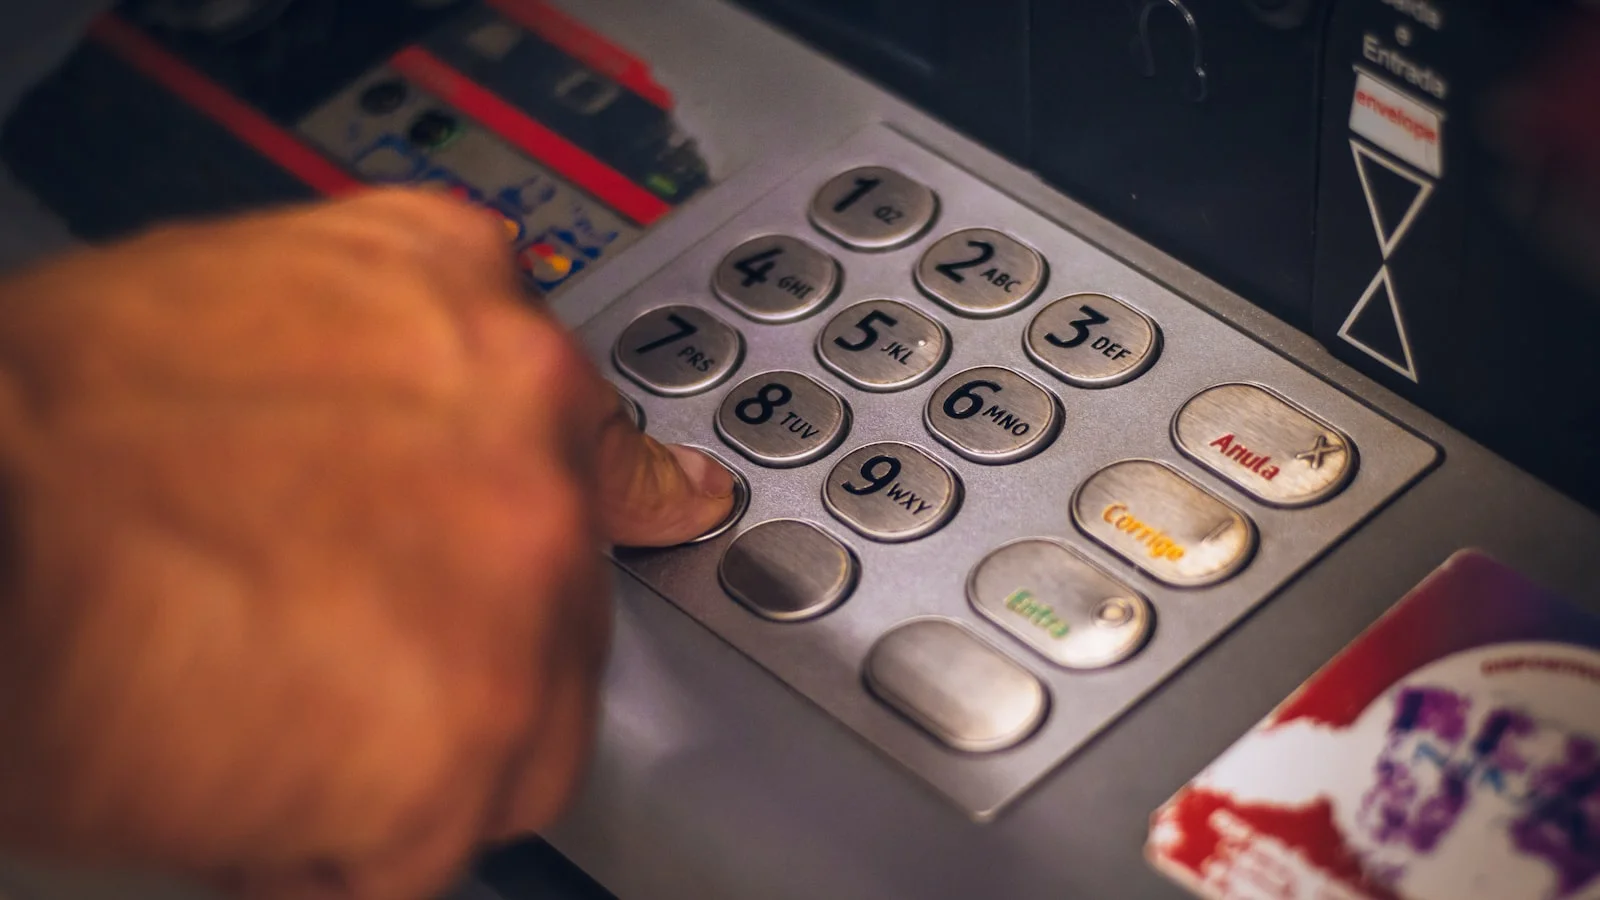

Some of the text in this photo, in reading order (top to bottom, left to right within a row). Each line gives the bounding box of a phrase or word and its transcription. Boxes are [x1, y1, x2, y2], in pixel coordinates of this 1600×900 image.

[1395, 26, 1410, 46] e
[1363, 34, 1446, 99] Entrada
[1356, 91, 1437, 144] envelope
[833, 177, 881, 214] 1
[733, 247, 814, 300] 4 GHI
[935, 240, 1021, 294] 2 ABC
[635, 313, 715, 372] 7 PRS
[834, 309, 914, 366] 5 JKL
[1044, 304, 1131, 362] 3 DEF
[735, 382, 820, 440] 8 TUV
[942, 379, 1030, 436] 6 MNO
[841, 455, 932, 516] 9 WXY
[1210, 433, 1281, 481] Anula
[1102, 503, 1185, 561] Corrige
